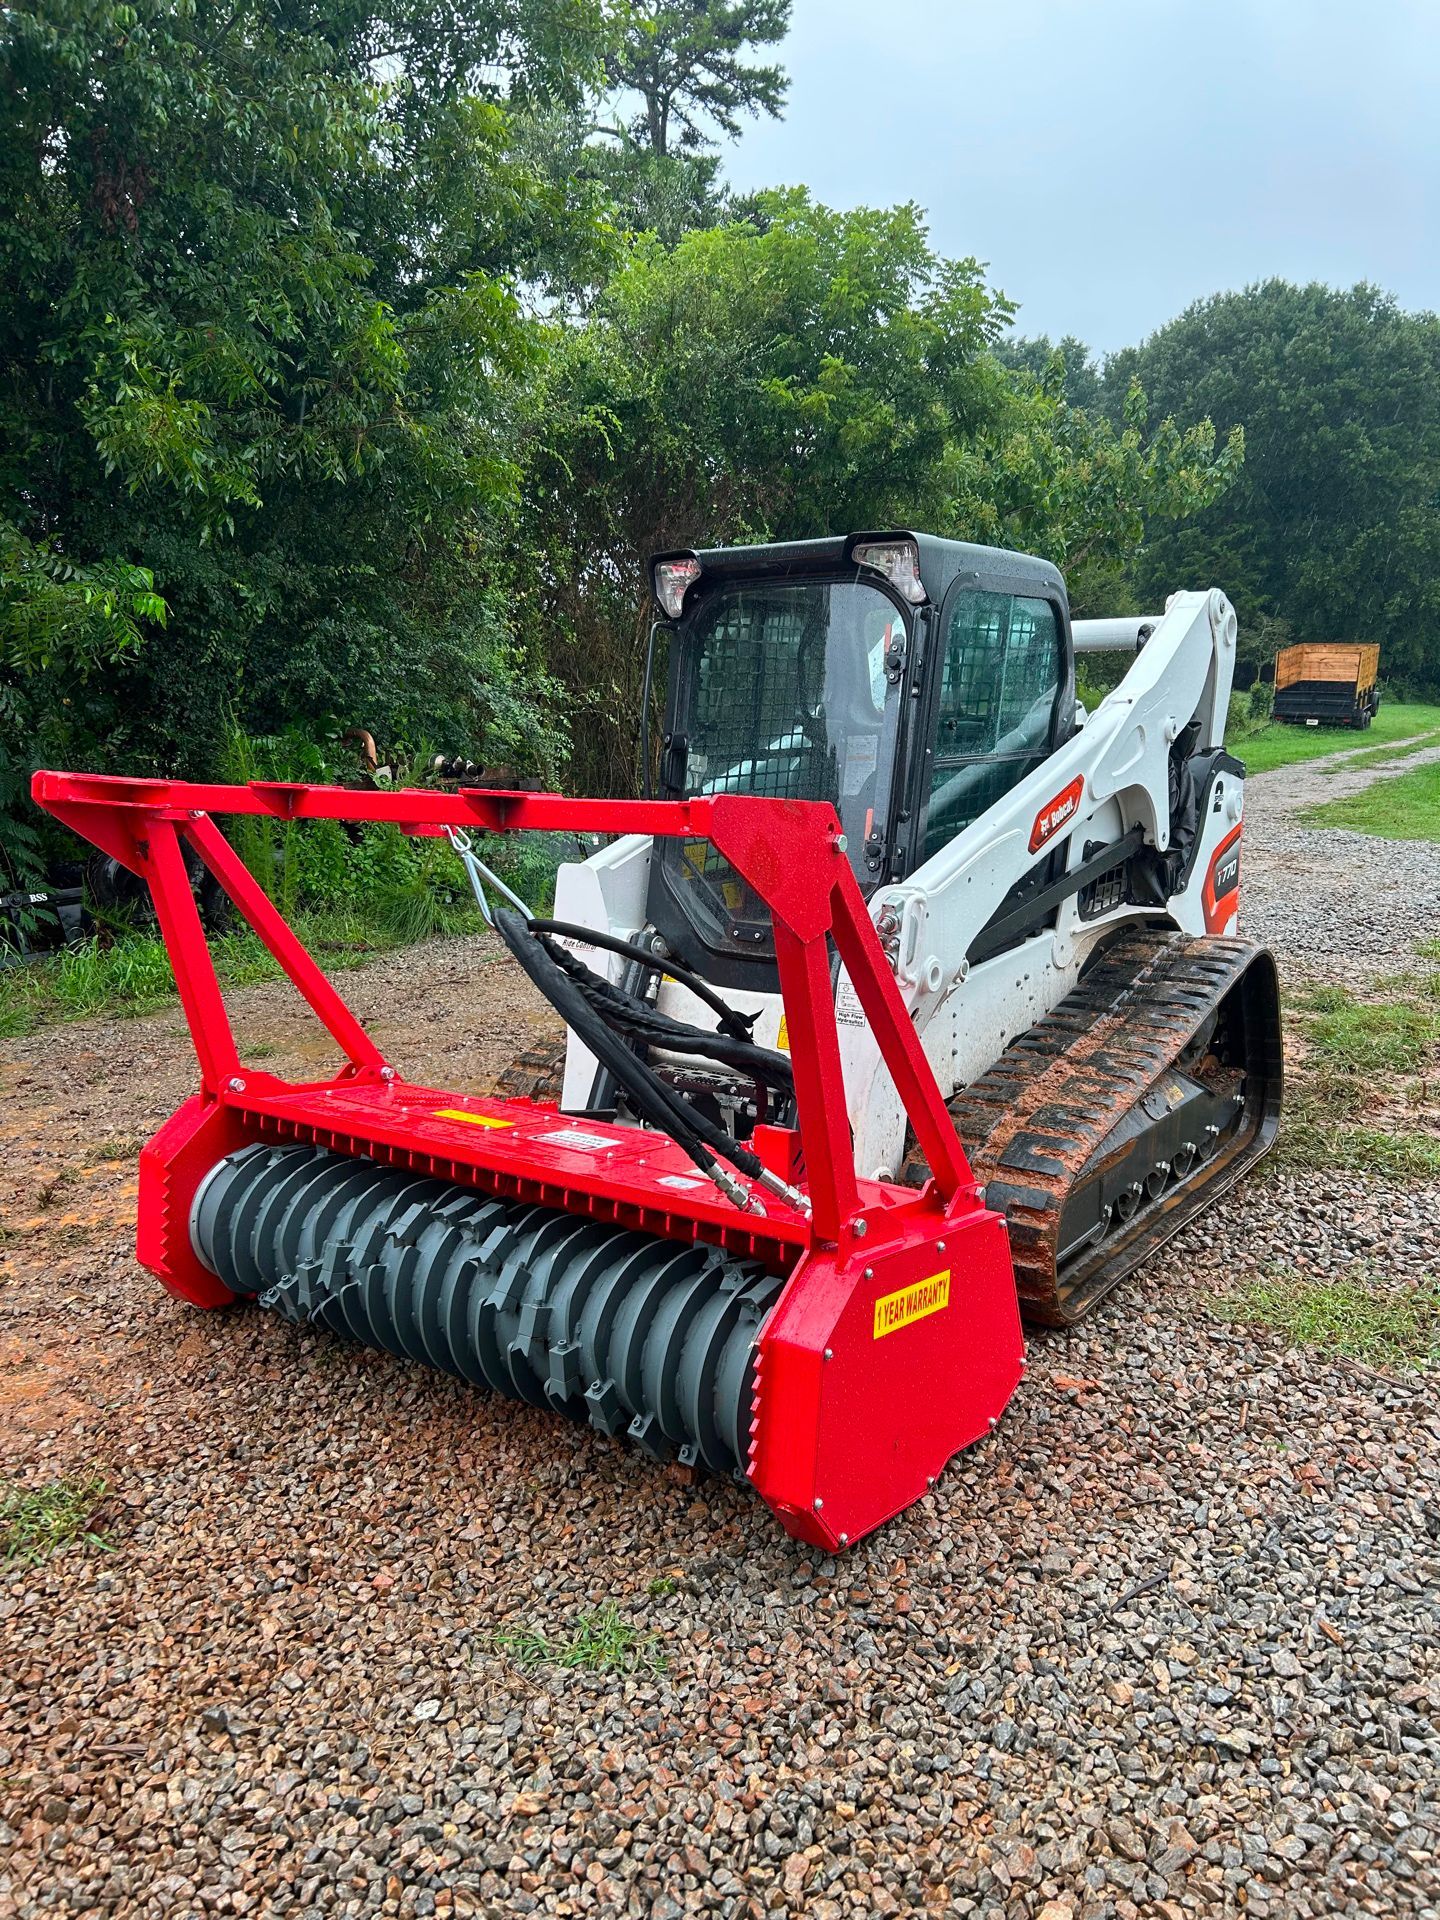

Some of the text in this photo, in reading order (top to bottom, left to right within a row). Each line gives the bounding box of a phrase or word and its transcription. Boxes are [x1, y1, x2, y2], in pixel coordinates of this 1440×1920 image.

[1051, 796, 1073, 828] Bobcat
[1217, 859, 1237, 887] T770
[29, 893, 48, 902] BSS
[877, 1278, 948, 1330] 1 YEAR WARRANTY
